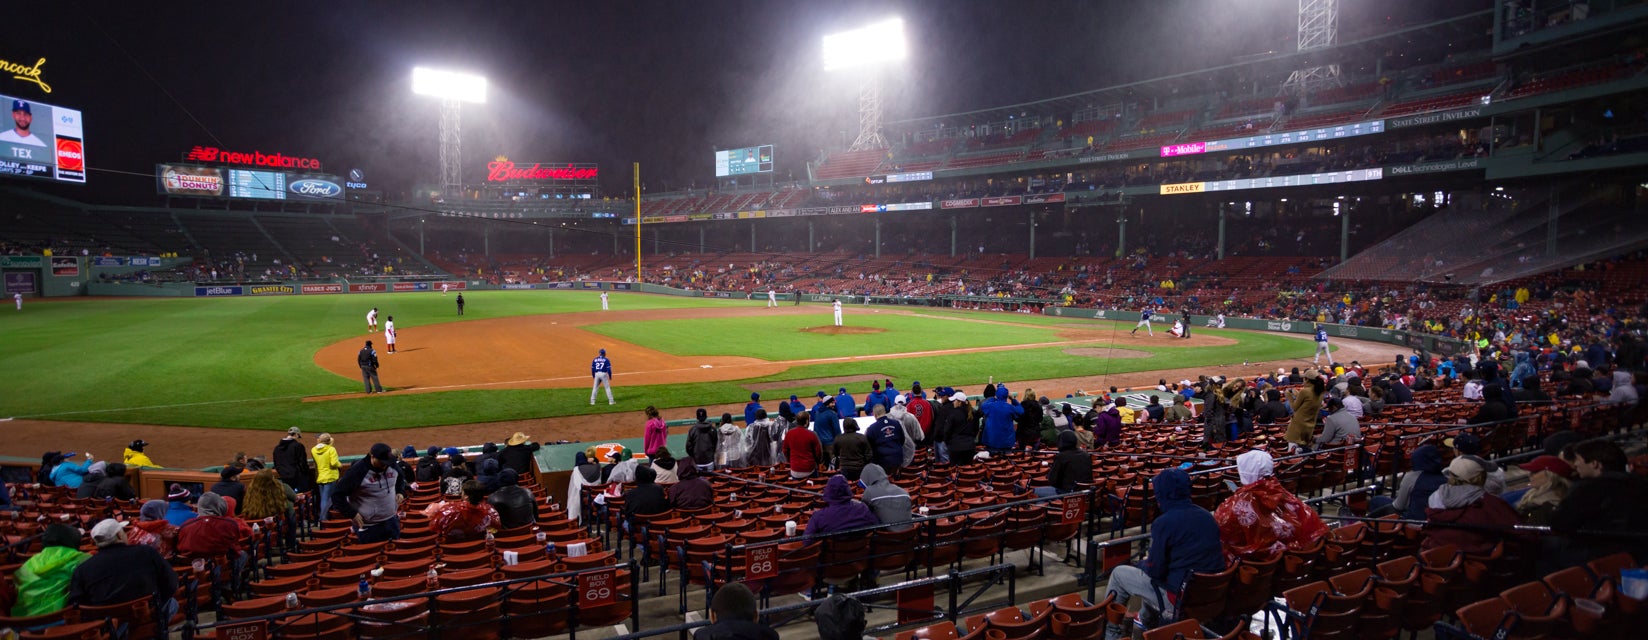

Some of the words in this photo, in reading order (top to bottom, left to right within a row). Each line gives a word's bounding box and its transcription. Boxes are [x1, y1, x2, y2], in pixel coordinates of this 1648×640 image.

[1392, 119, 1413, 128] STATE
[1414, 116, 1440, 125] STREET
[1443, 109, 1480, 121] PAVILION
[11, 147, 32, 159] TEX
[58, 150, 81, 160] ENEOS
[220, 150, 254, 165] new
[255, 150, 321, 169] balance
[488, 161, 598, 181] Budweiser
[1392, 166, 1412, 174] DELL
[1412, 162, 1456, 172] Technologies
[1458, 160, 1478, 168] Level
[1368, 169, 1381, 178] 9TH
[181, 175, 220, 183] DUNKIN'
[182, 182, 218, 190] DONUTS
[300, 182, 331, 195] Ford
[346, 181, 367, 189] tyco
[1166, 184, 1200, 192] STANLEY
[206, 286, 232, 296] jetBlue
[252, 285, 279, 294] GRANITE
[595, 362, 605, 370] 27
[1065, 508, 1080, 519] 67
[752, 547, 772, 555] FIELD
[751, 561, 772, 573] 68
[586, 573, 609, 581] FIELD
[590, 580, 606, 588] BOX
[586, 587, 610, 601] 69
[226, 625, 258, 636] FIELD
